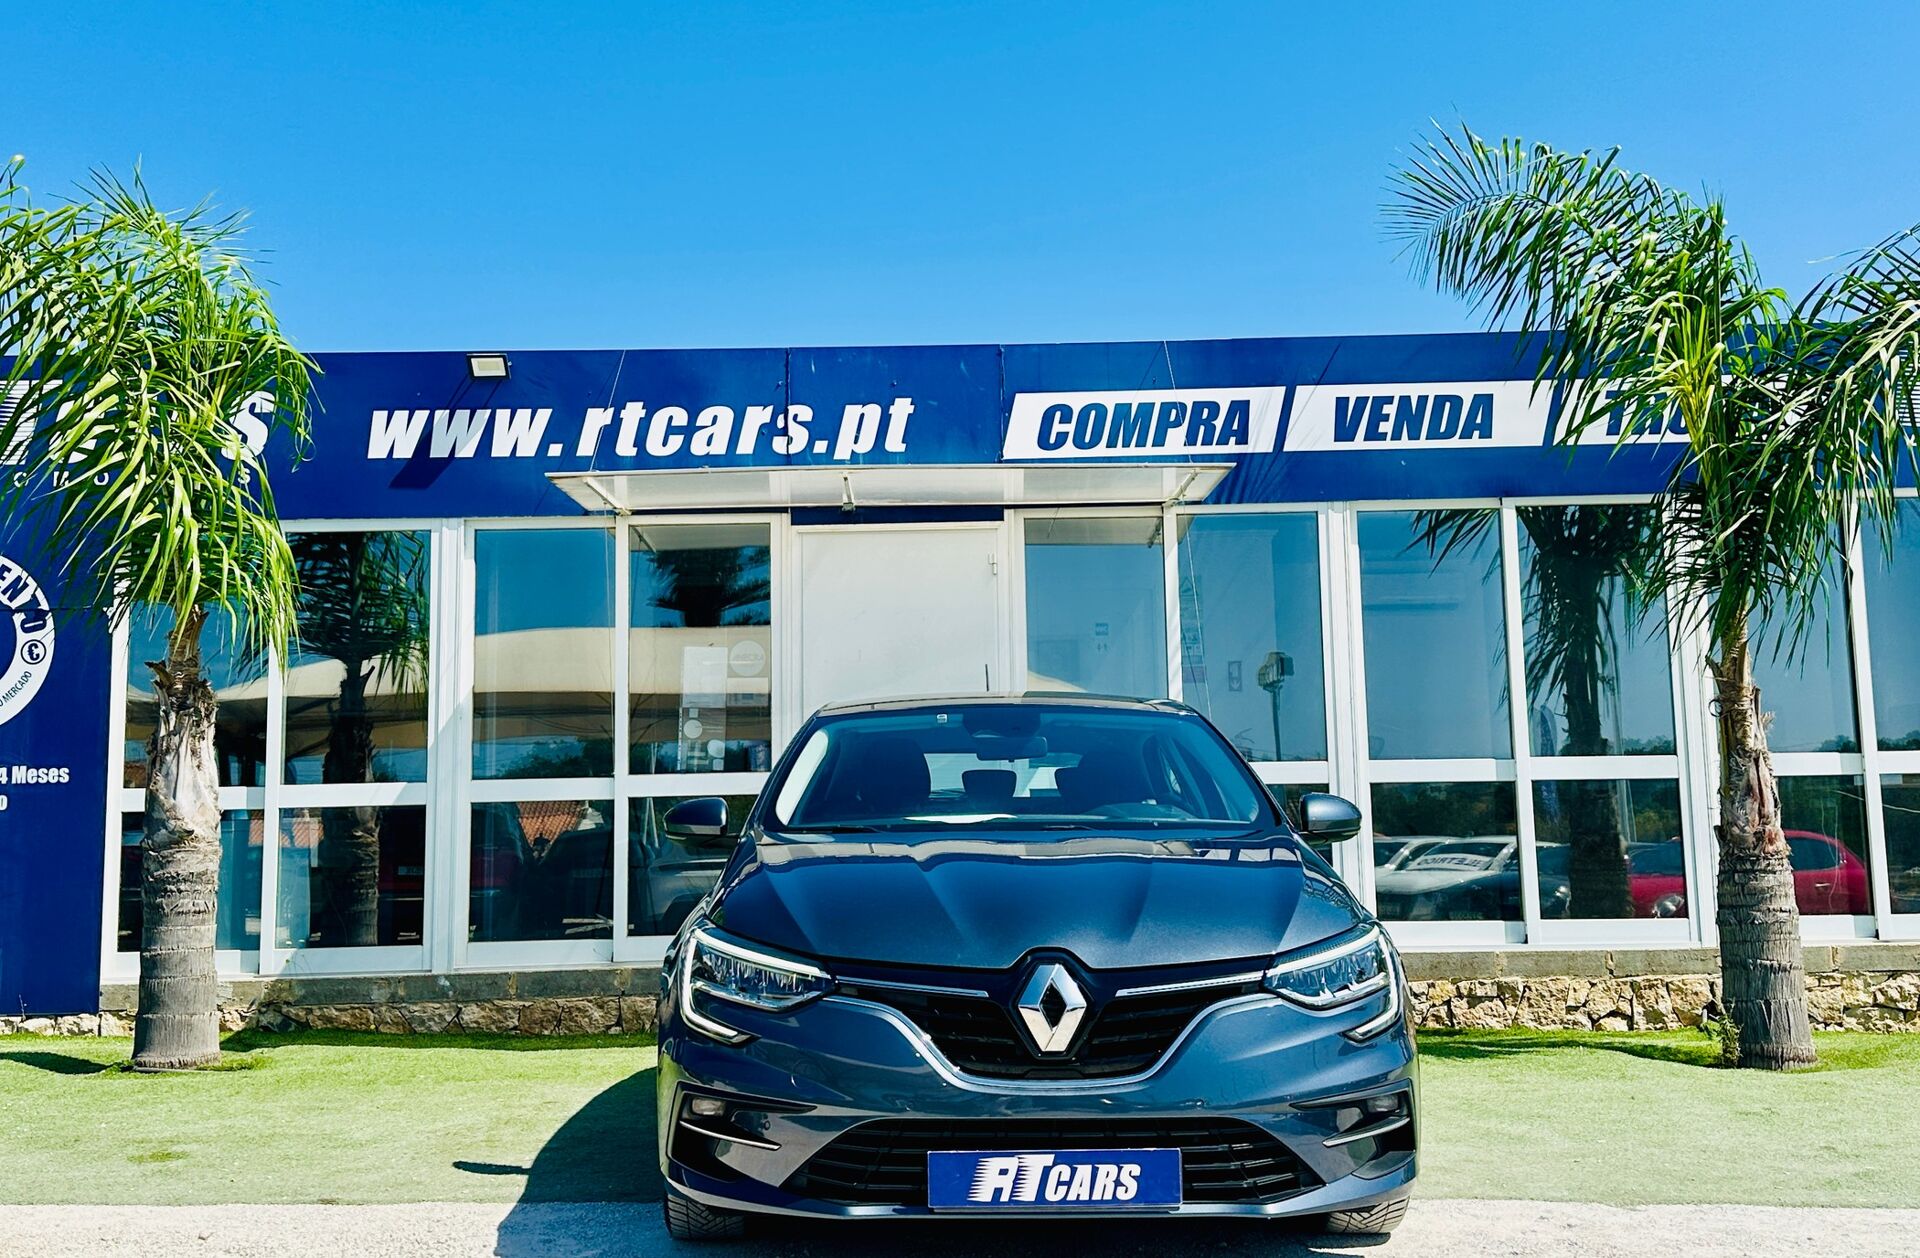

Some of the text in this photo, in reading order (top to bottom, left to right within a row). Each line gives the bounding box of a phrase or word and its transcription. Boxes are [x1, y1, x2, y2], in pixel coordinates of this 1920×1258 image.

[367, 397, 915, 460] www.rtcars.pt
[1036, 399, 1252, 451] COMPRA
[1333, 393, 1495, 443] VENDA
[2, 670, 32, 702] MERCADO
[11, 765, 70, 784] Meses
